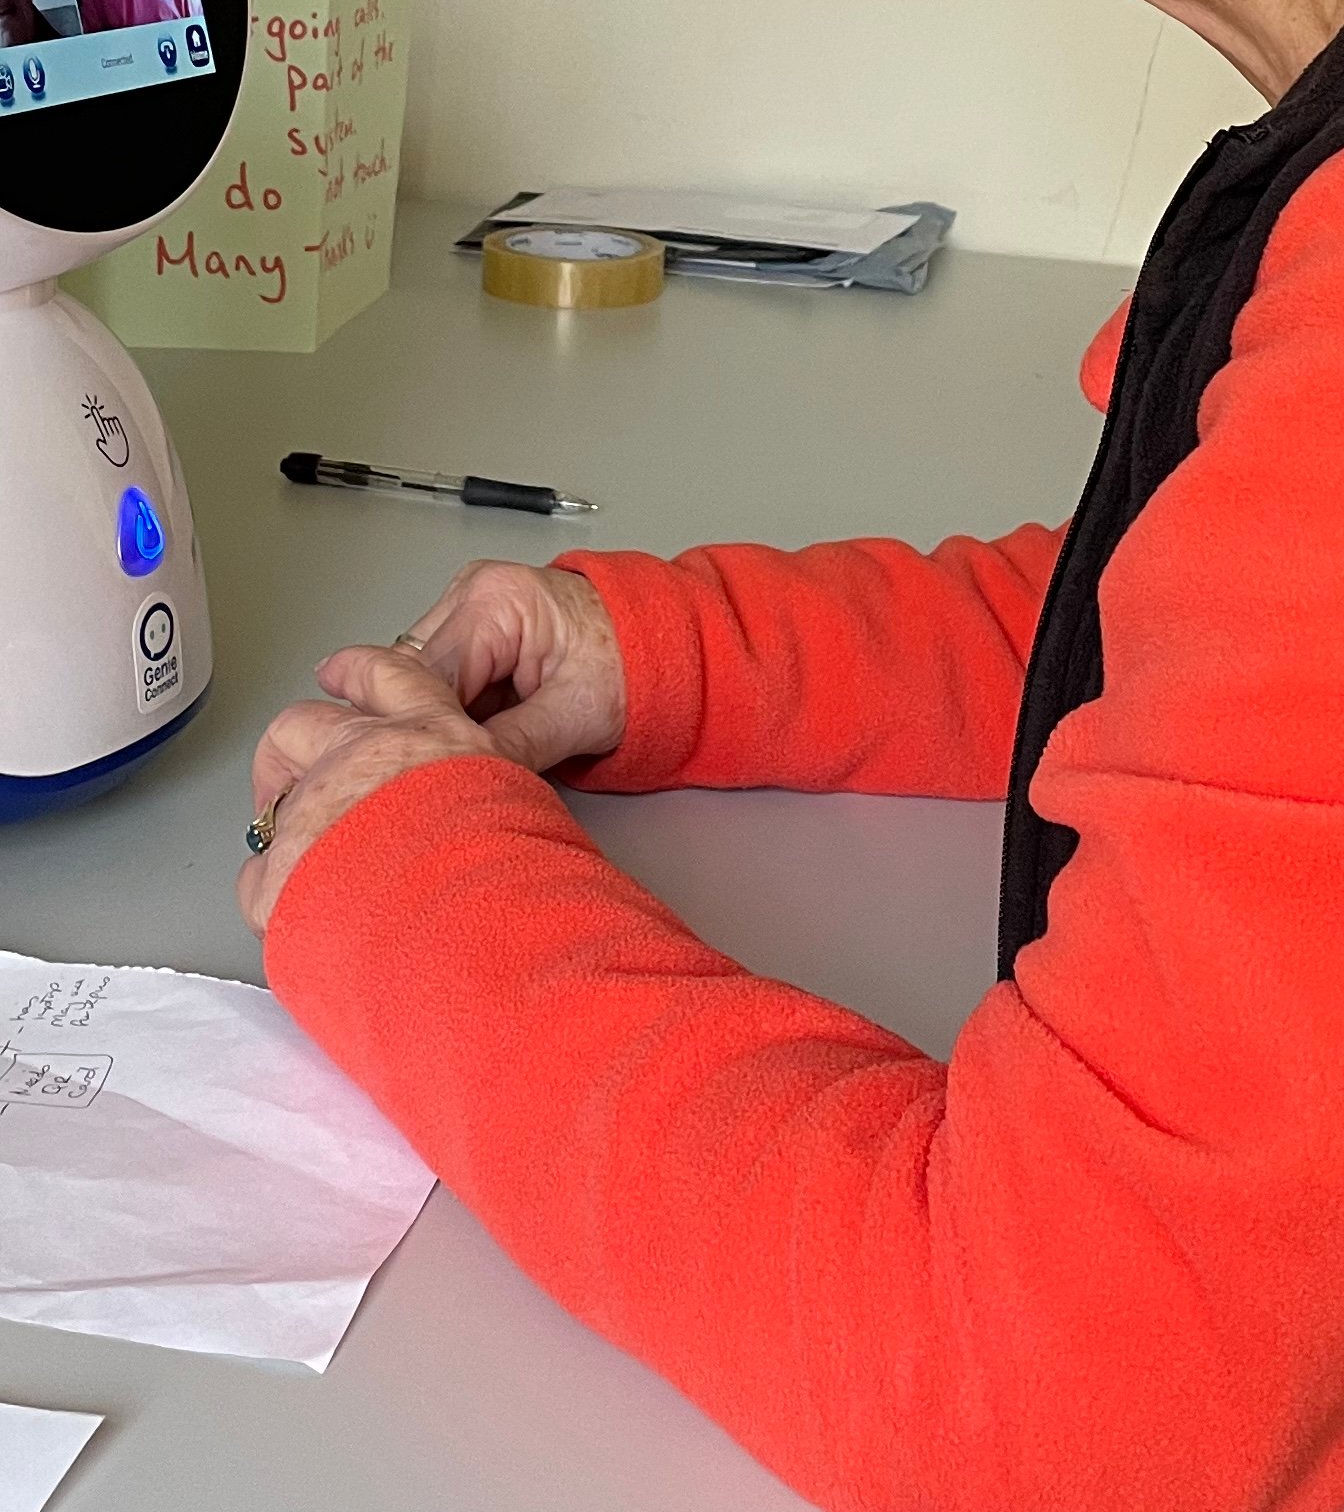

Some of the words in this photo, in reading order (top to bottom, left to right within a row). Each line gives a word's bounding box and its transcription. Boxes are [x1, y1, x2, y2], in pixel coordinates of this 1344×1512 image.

[288, 55, 342, 112] part
[374, 29, 393, 70] the
[225, 161, 282, 212] do
[326, 157, 344, 203] not
[157, 232, 286, 303] Many
[144, 656, 177, 686] Genie
[145, 671, 178, 702] Connect
[42, 1075, 72, 1094] QR
